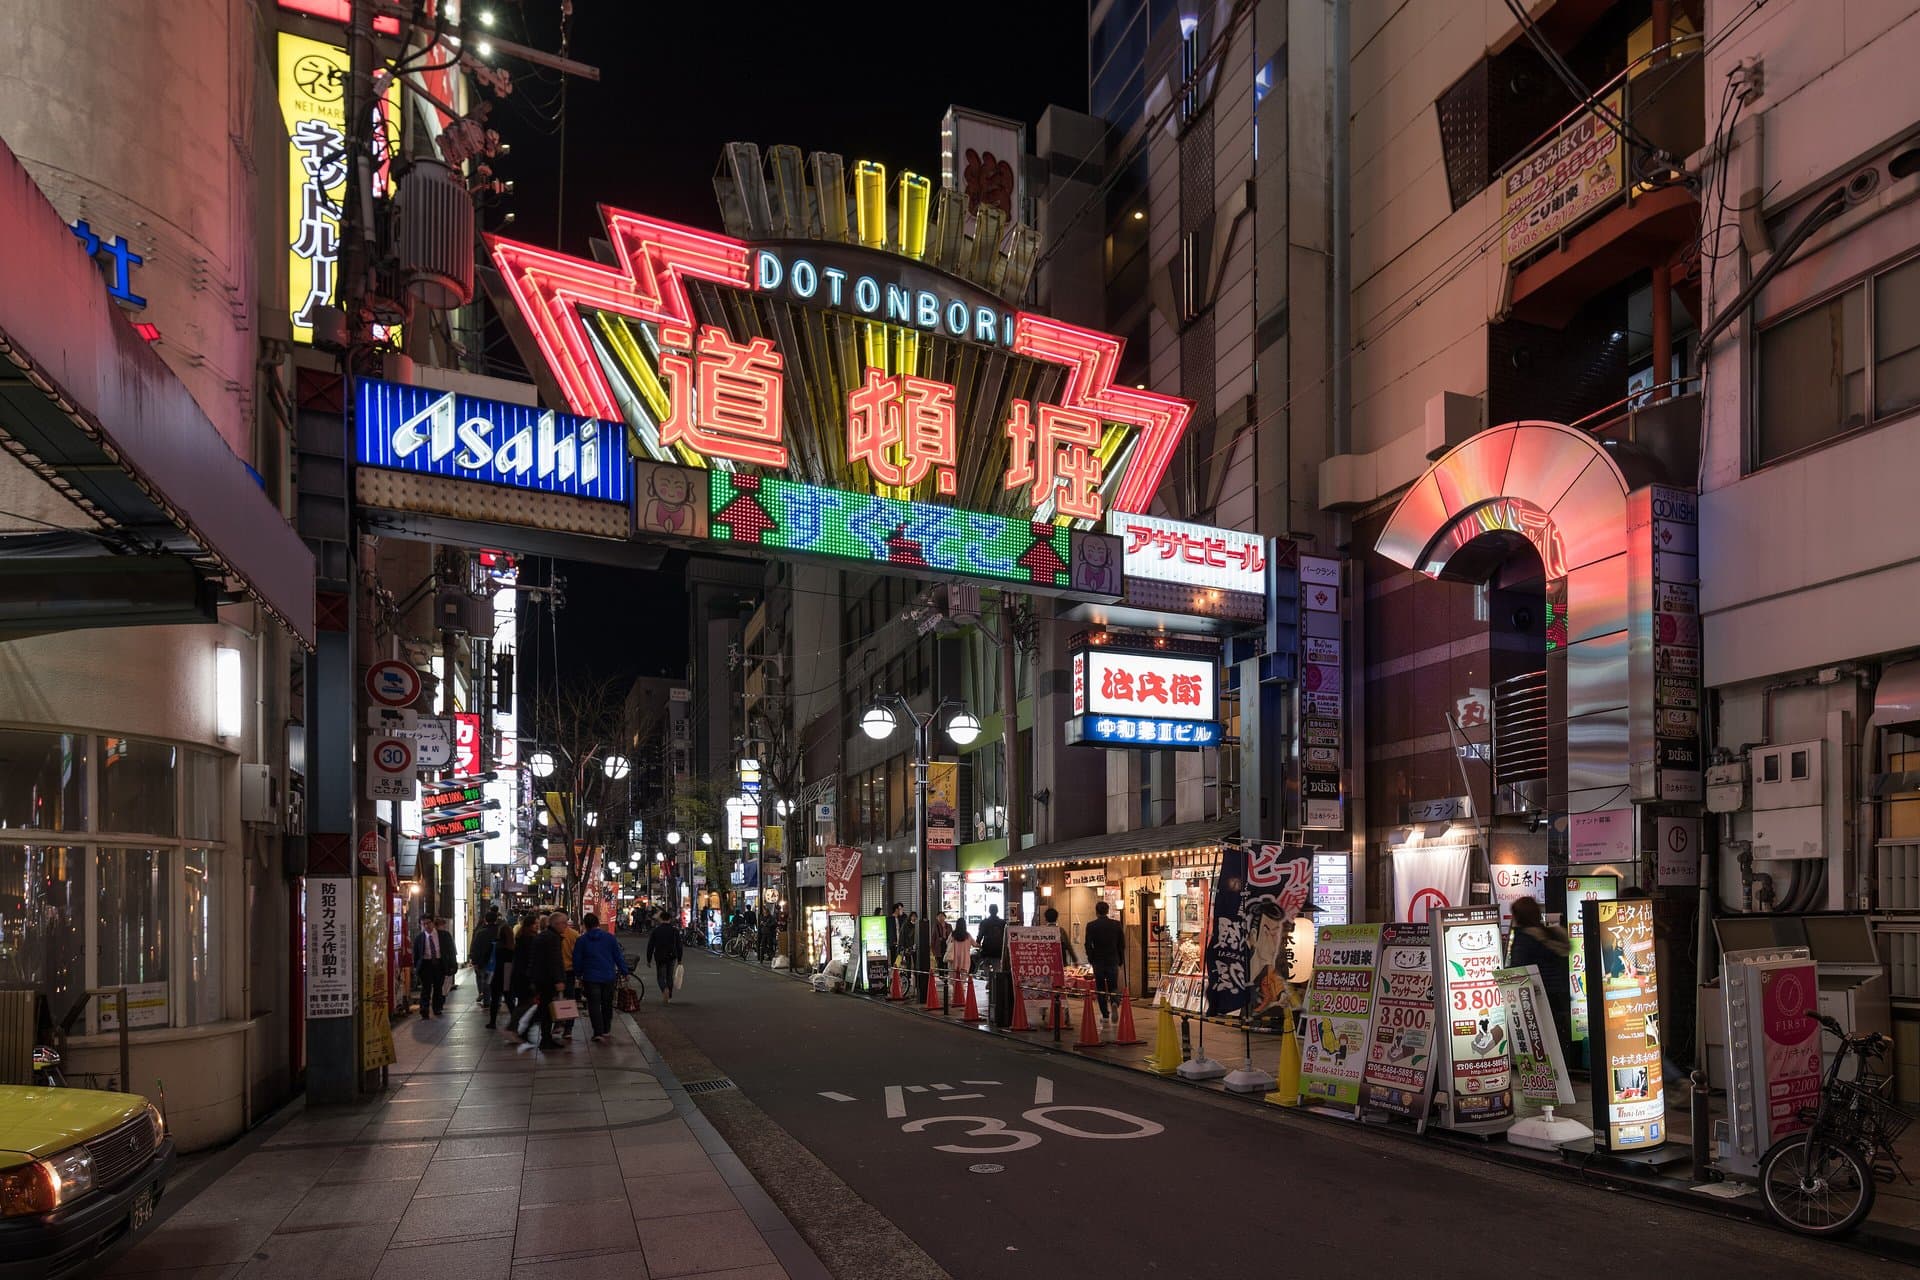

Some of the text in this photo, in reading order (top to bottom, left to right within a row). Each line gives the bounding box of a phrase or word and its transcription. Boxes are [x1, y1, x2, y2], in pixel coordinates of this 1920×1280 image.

[294, 101, 317, 115] NET
[291, 118, 347, 326] ネットルー
[757, 248, 1014, 347] DOTONBORI
[658, 322, 1103, 521] 道頓堀
[391, 390, 599, 486] Asahi
[778, 486, 1014, 575] すぐそこ
[1126, 523, 1266, 573] アサヒビール
[1100, 666, 1203, 707] 治兵衛
[383, 749, 404, 765] 30
[456, 719, 475, 780] カラ
[374, 787, 410, 796] ここから
[1310, 780, 1337, 793] DUSK
[1248, 845, 1313, 887] ビール
[1568, 880, 1578, 889] 4F
[1600, 905, 1613, 916] 7F
[321, 882, 337, 979] 防犯カメラ作動中
[1332, 950, 1373, 965] こり道楽
[1316, 971, 1370, 987] 全身もみほぐし
[1761, 972, 1772, 985] 6F
[1391, 986, 1426, 998] マッサージ
[1323, 994, 1368, 1014] 2,800円
[1775, 1018, 1809, 1034] FIRST
[901, 1105, 1165, 1155] 30
